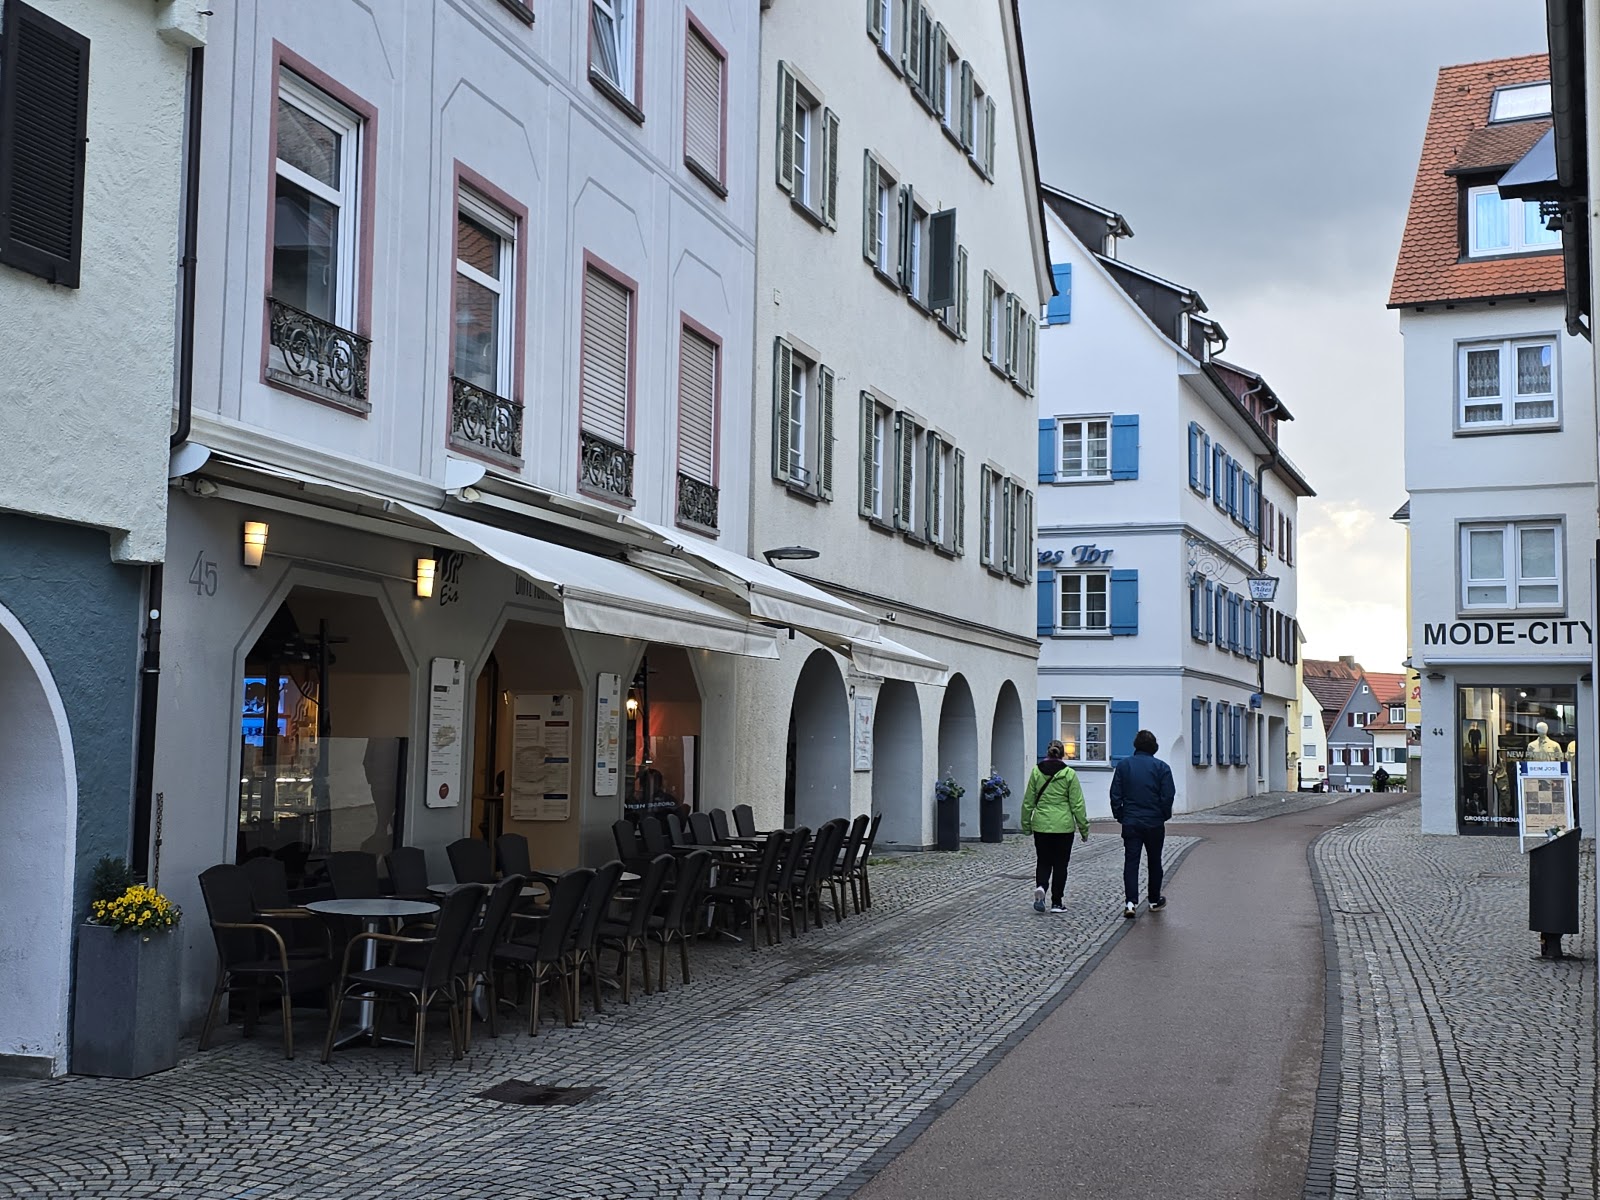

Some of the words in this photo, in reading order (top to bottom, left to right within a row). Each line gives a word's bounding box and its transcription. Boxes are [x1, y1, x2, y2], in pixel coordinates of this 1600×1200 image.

[1071, 543, 1114, 564] Tor
[188, 550, 218, 597] 45
[439, 584, 459, 606] Eis
[1424, 621, 1592, 646] MODE-CITY
[1432, 727, 1444, 736] 44
